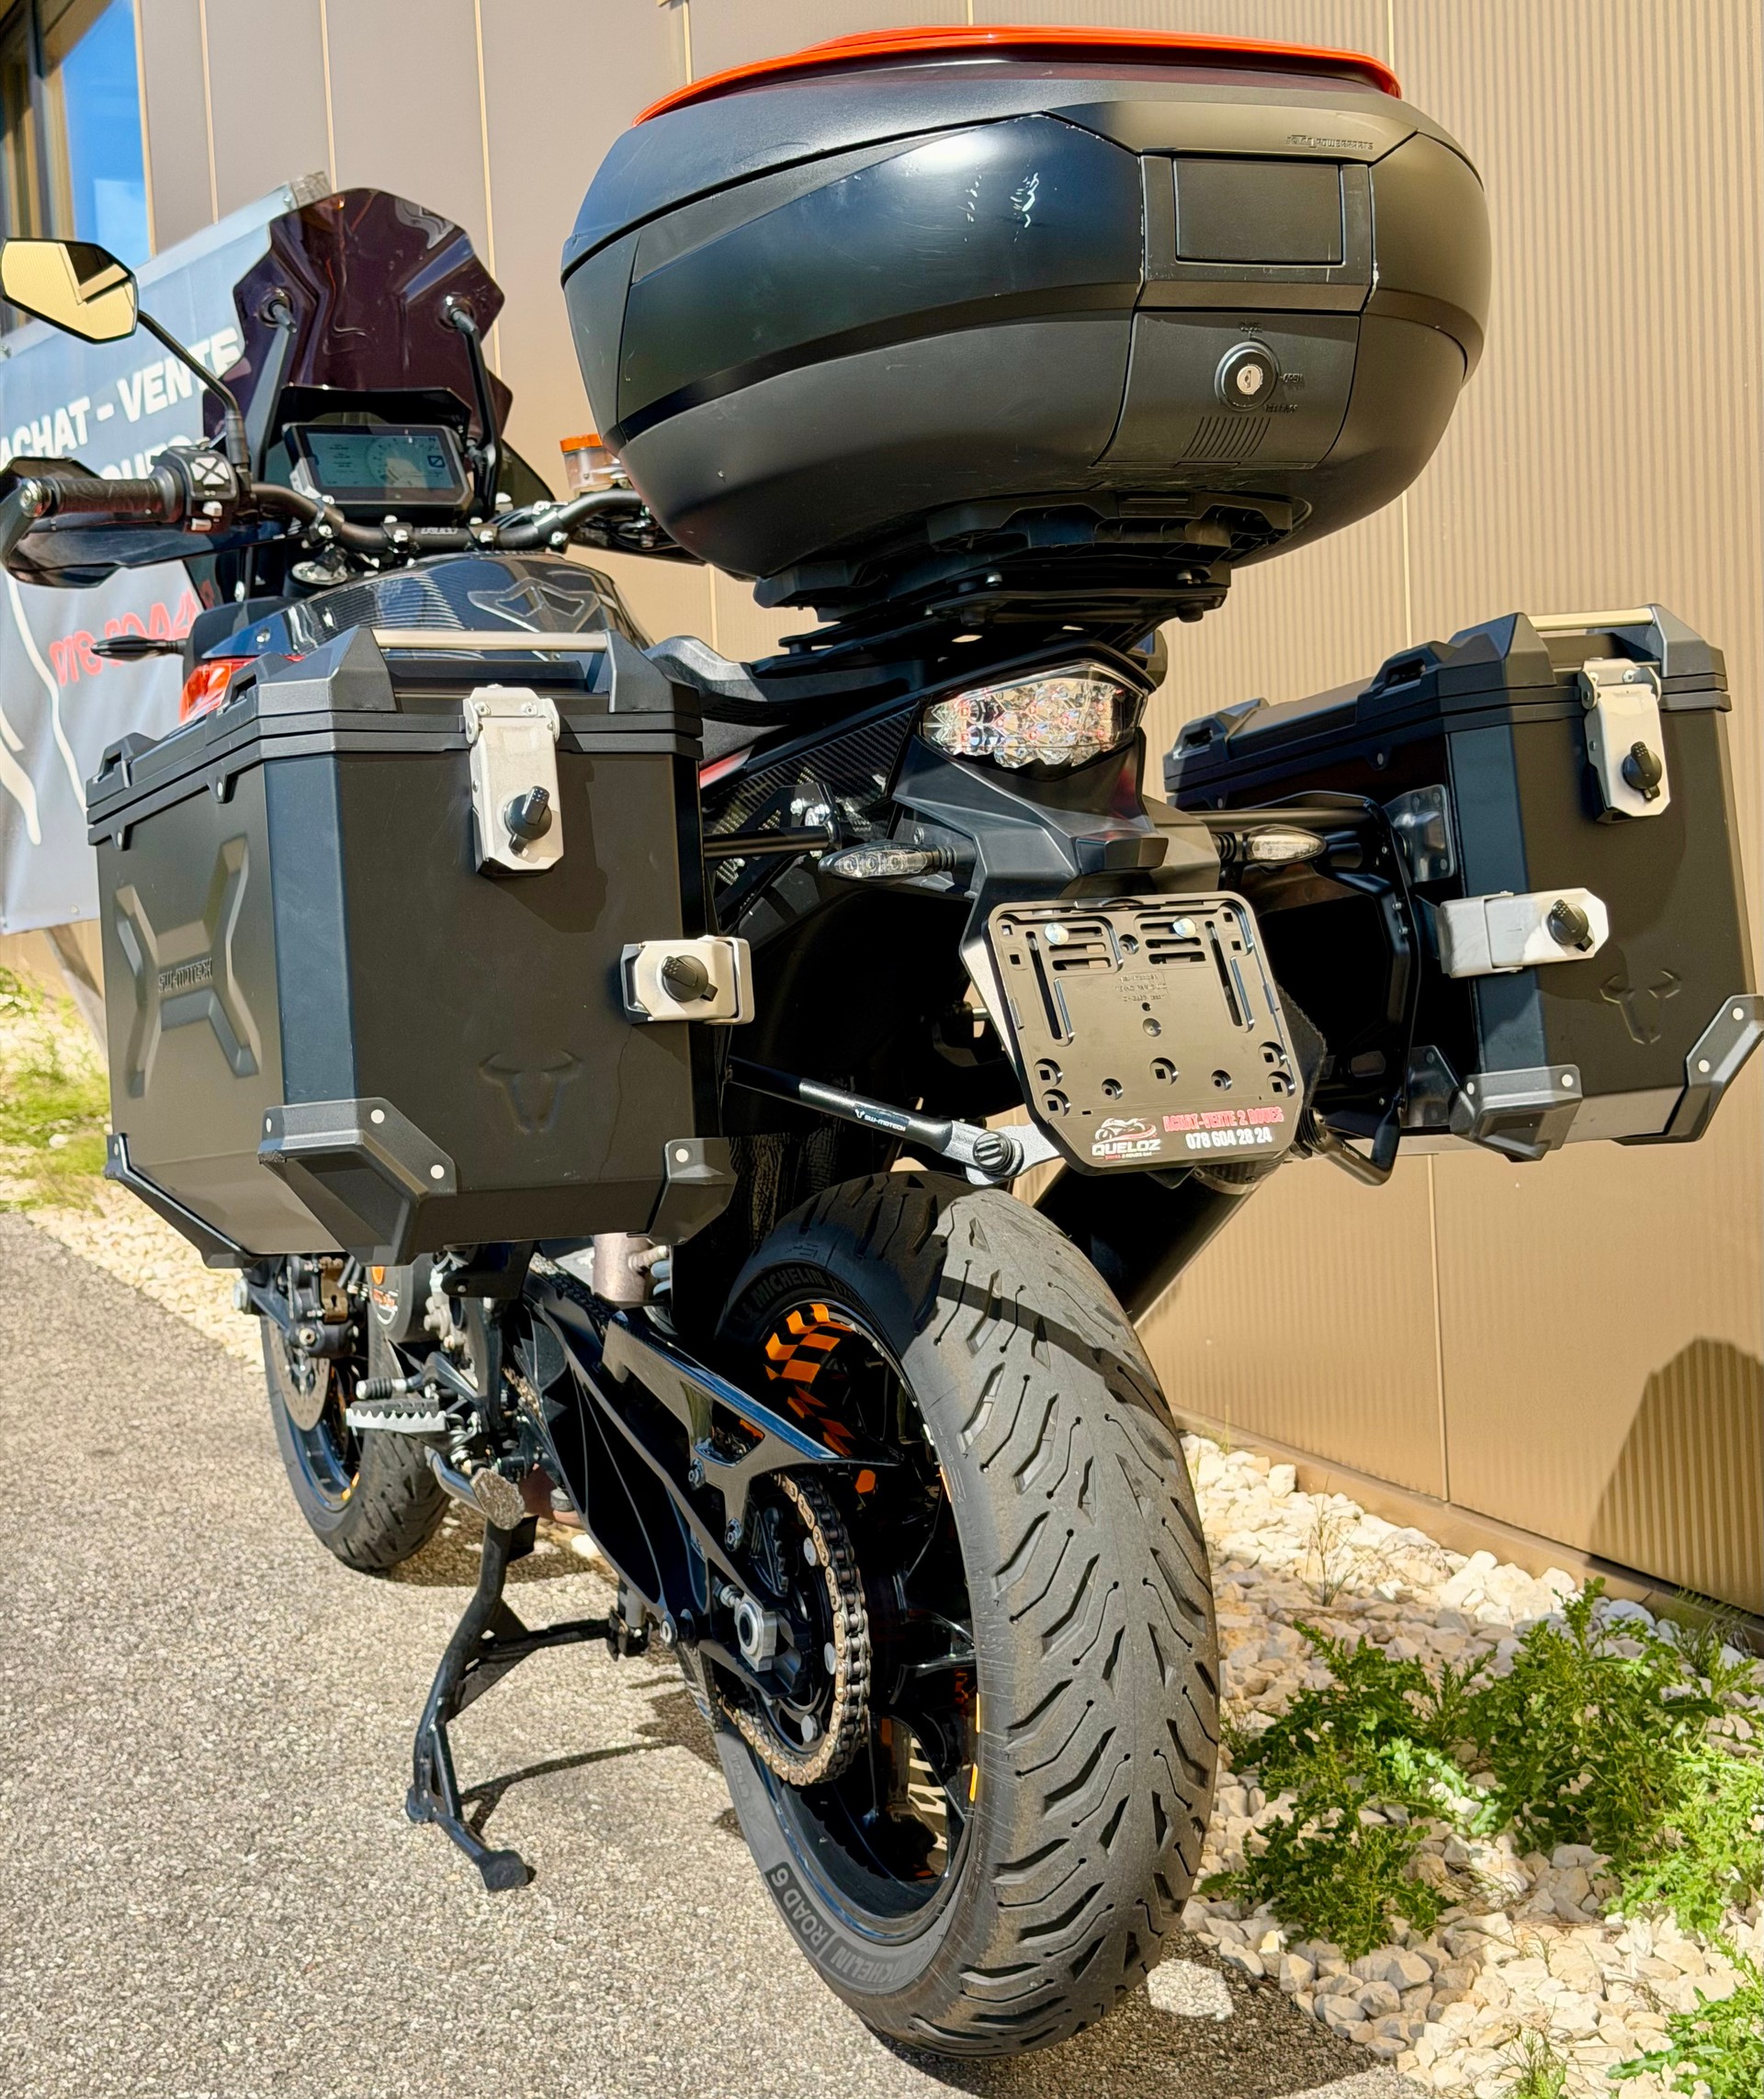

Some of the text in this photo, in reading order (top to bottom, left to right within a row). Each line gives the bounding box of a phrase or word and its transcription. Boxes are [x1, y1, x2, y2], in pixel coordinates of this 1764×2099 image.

[116, 326, 243, 423] VENTE
[1091, 1138, 1162, 1157] QUELOZ
[1185, 1131, 1211, 1150] 078
[1211, 1130, 1236, 1148] 604
[1254, 1126, 1273, 1144] 24
[751, 1266, 828, 1310] MICHELIN
[770, 1867, 790, 1888] 6
[783, 1890, 826, 1947] ROAD
